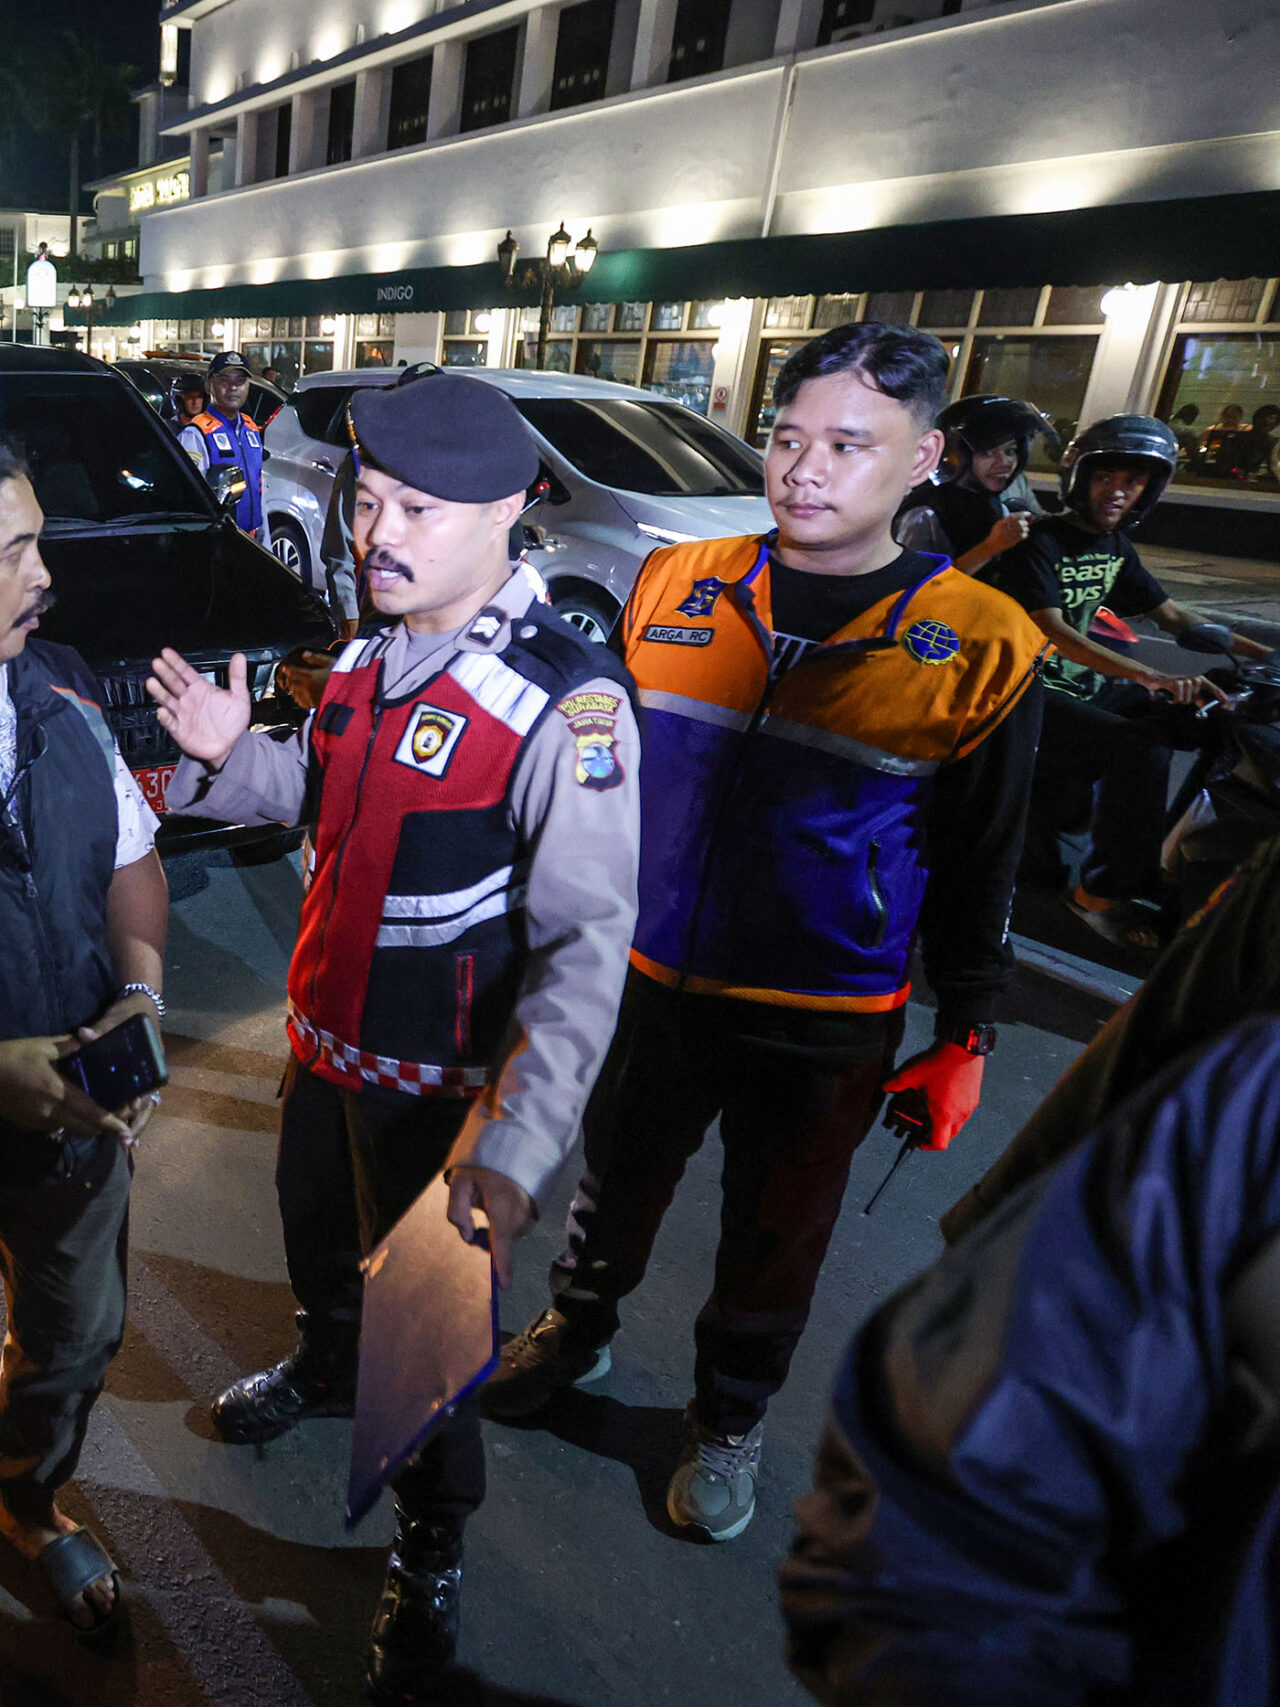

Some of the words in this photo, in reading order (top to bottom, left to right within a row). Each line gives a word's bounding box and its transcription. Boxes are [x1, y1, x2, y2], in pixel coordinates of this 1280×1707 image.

[377, 285, 414, 301] INDIGO
[649, 629, 684, 641] ARGA
[689, 630, 709, 642] RC
